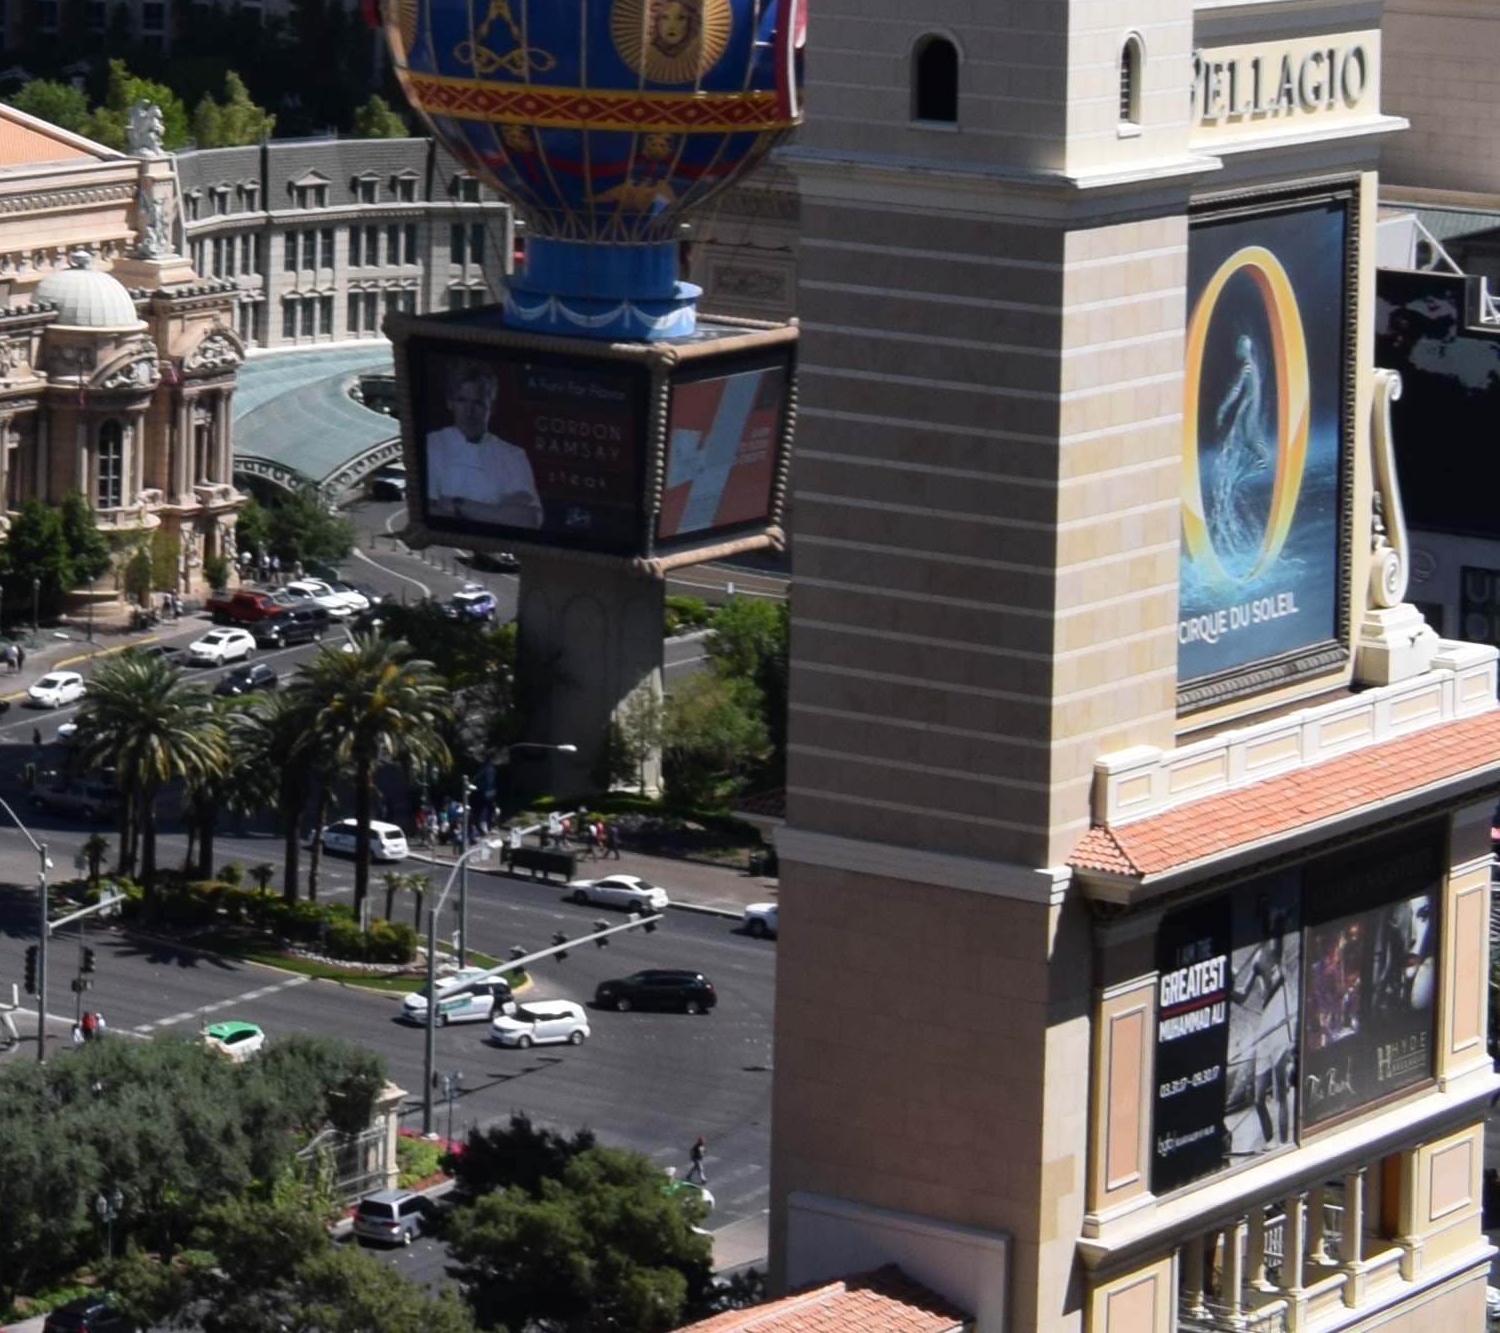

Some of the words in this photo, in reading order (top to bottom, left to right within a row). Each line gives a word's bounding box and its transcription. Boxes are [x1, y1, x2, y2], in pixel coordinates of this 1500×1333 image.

[535, 416, 621, 441] GORDON
[535, 436, 621, 461] RAMSAY
[549, 470, 606, 490] steak
[1178, 610, 1227, 644] CIRQUE
[1231, 605, 1250, 629] DU
[1252, 592, 1299, 623] SOLEIL
[1160, 955, 1227, 1007] GREATEST
[1159, 1007, 1211, 1042] MUHAMMAD
[1212, 1001, 1226, 1024] ALI
[1392, 1031, 1427, 1059] HYDE
[1307, 1074, 1325, 1107] The
